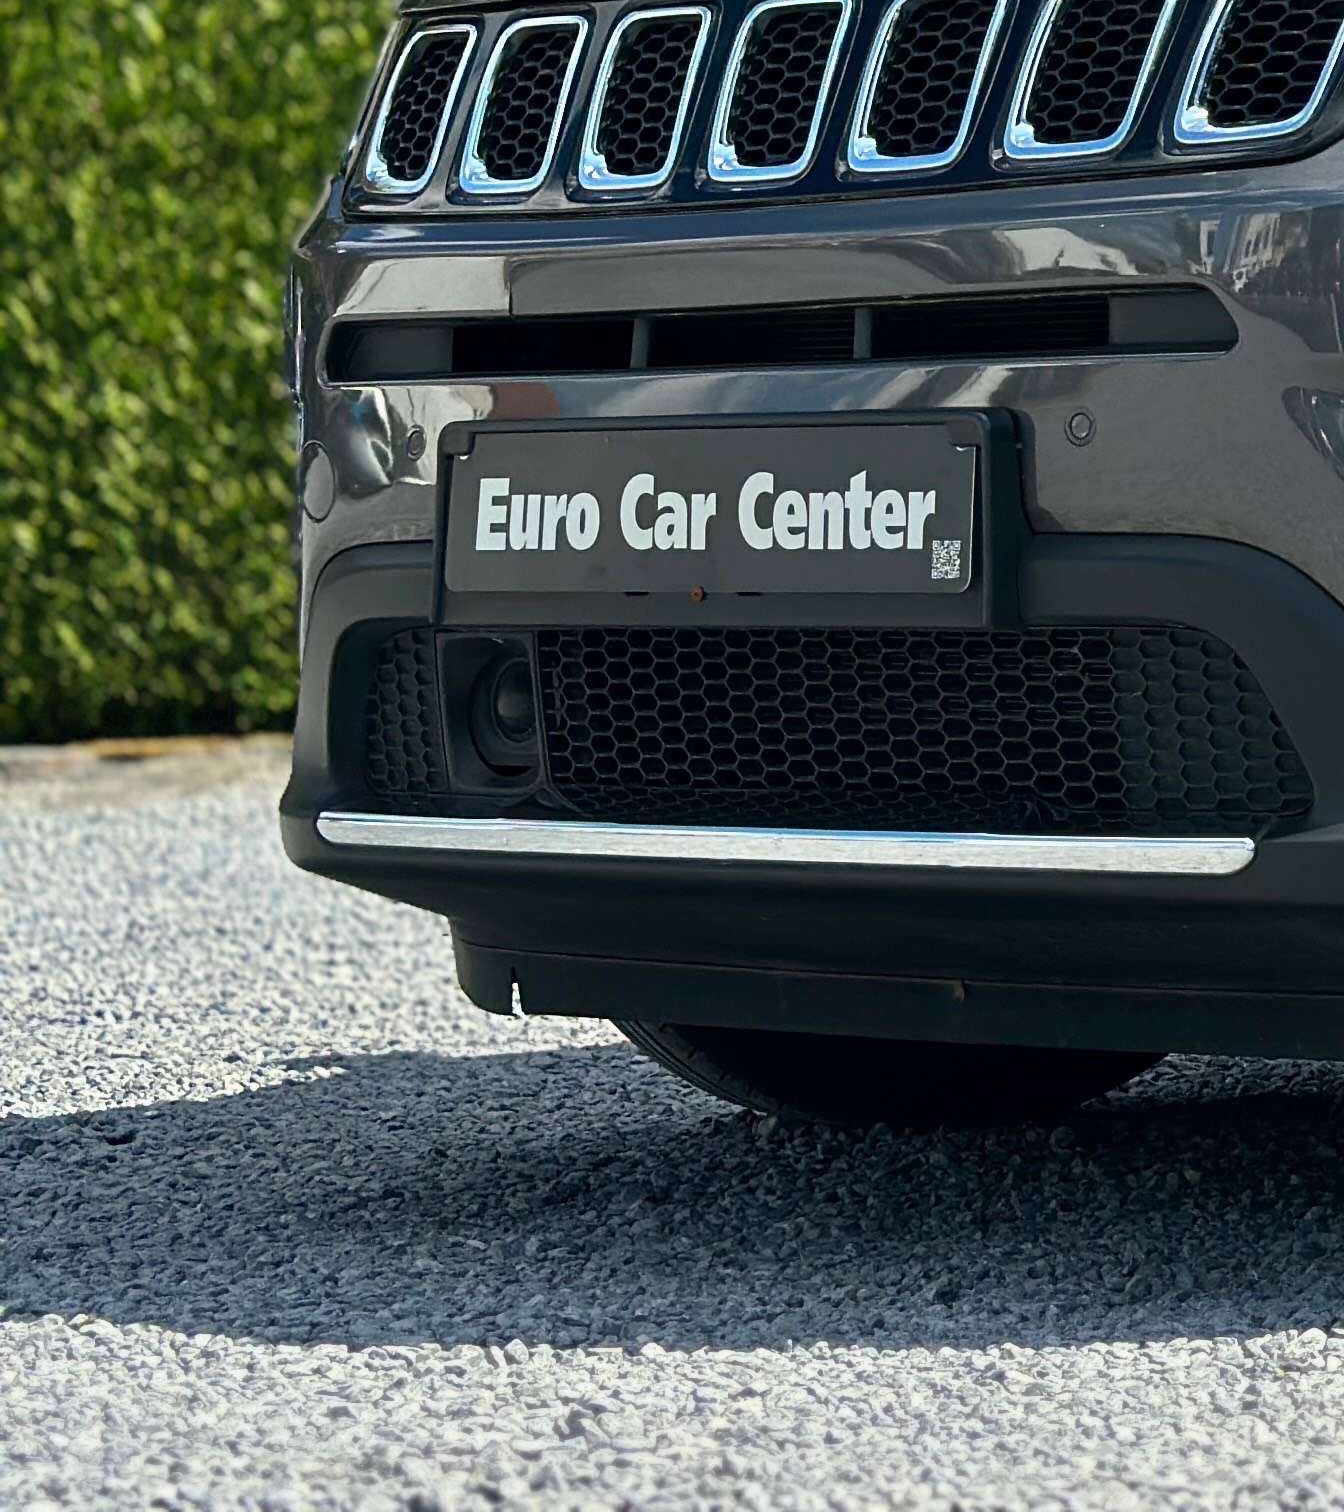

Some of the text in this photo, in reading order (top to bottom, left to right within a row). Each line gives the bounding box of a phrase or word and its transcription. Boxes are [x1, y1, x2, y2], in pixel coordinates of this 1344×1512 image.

[474, 469, 937, 552] Euro Car Center
